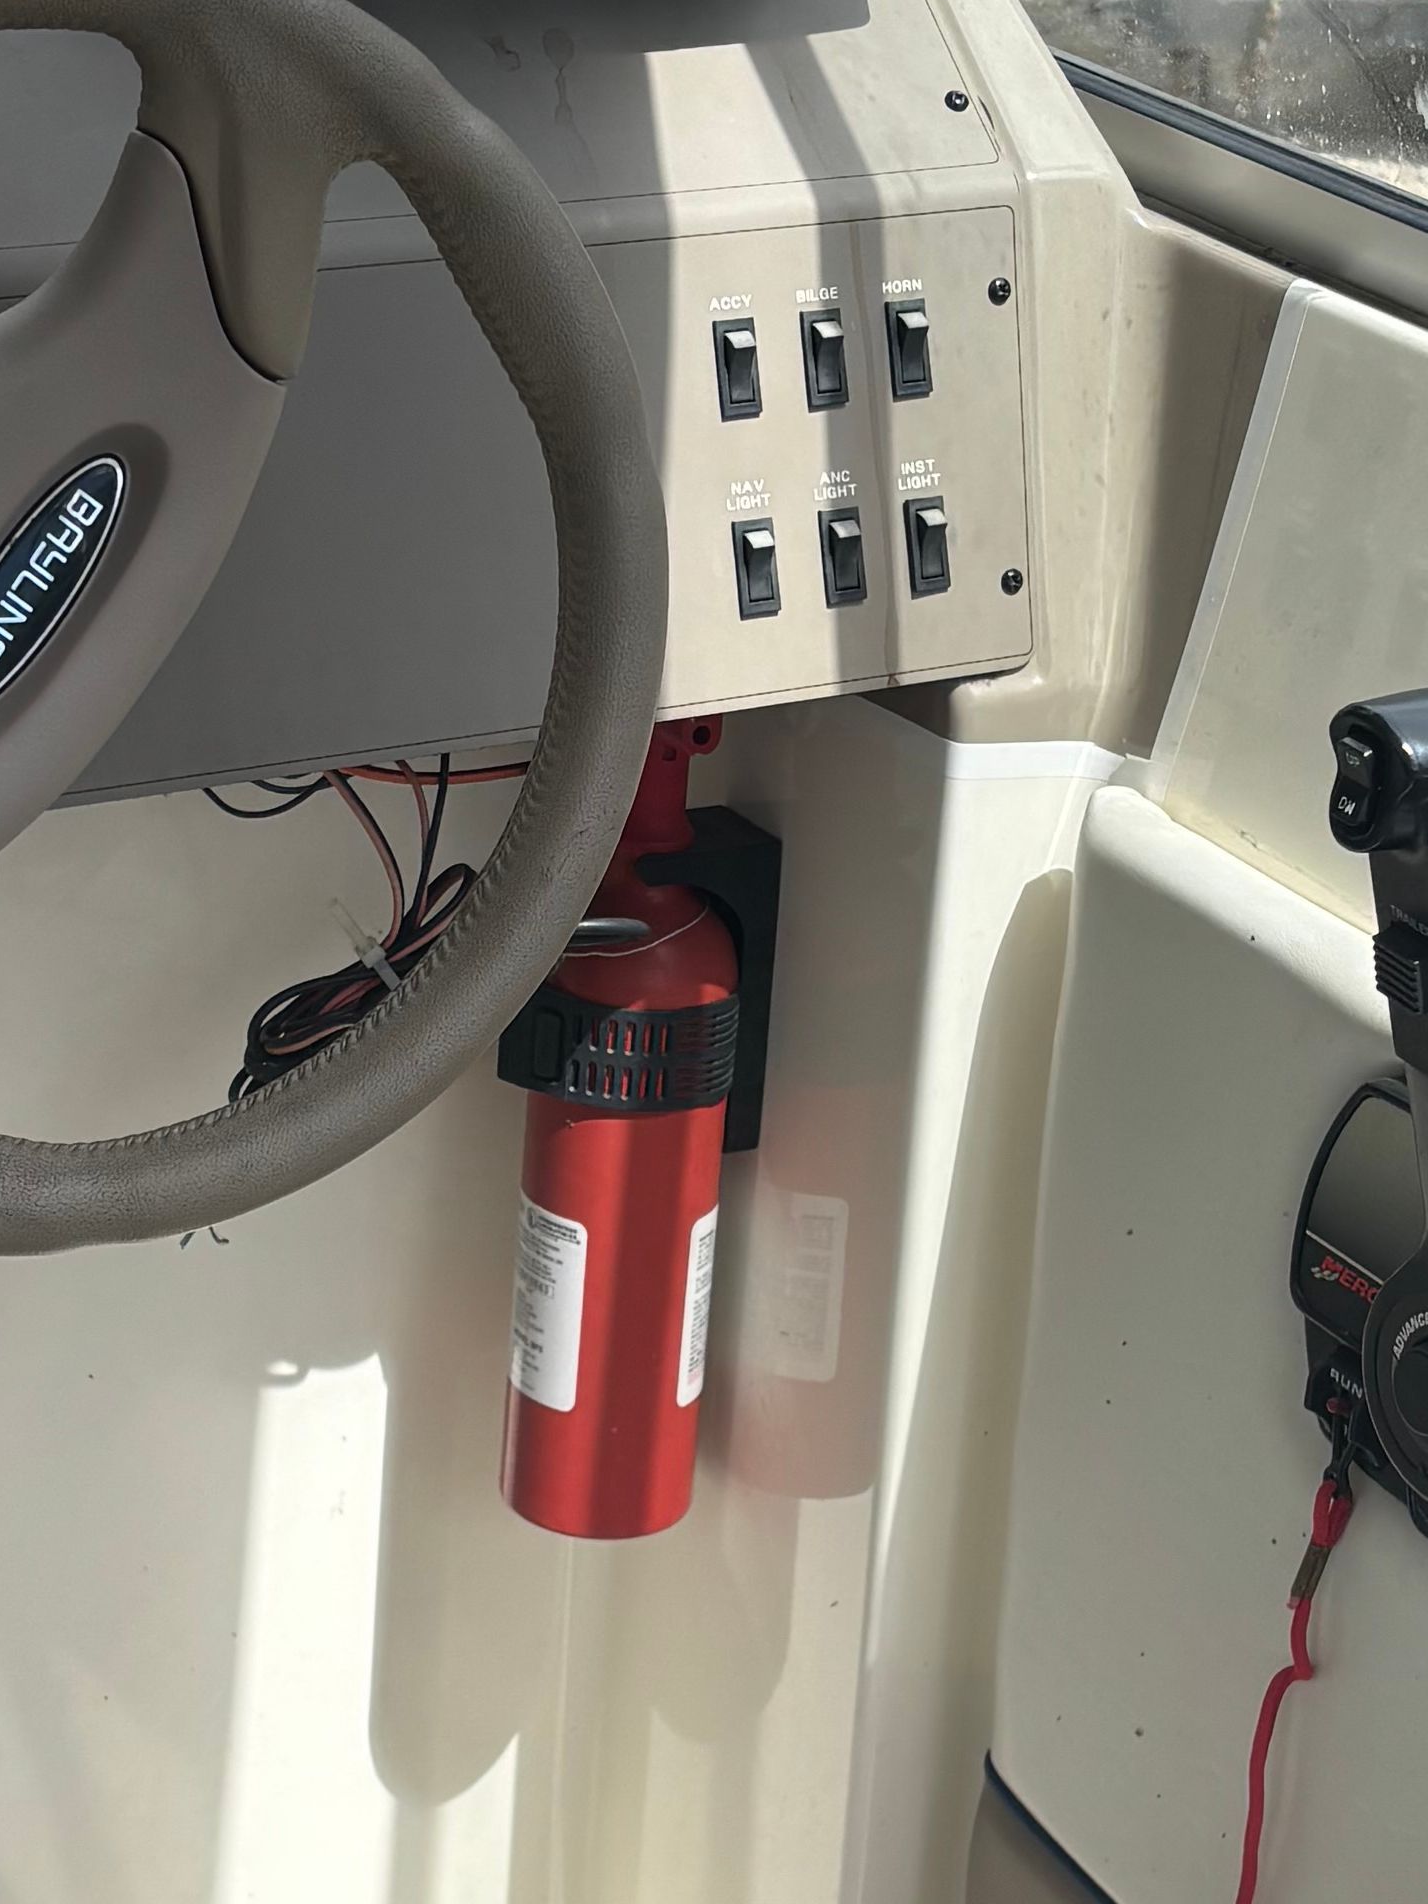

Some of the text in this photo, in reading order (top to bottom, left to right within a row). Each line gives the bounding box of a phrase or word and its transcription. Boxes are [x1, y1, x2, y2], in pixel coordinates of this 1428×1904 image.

[882, 279, 923, 294] HORN
[708, 295, 752, 311] ACCY
[795, 287, 839, 304] BILGE
[900, 459, 936, 475] INST
[819, 470, 851, 485] ANC
[898, 473, 941, 491] LIGHT
[731, 479, 765, 496] NAV
[814, 483, 857, 502] LIGHT
[726, 493, 772, 511] LIGHT
[1320, 1255, 1381, 1304] MERC
[1330, 1368, 1363, 1399] RUN
